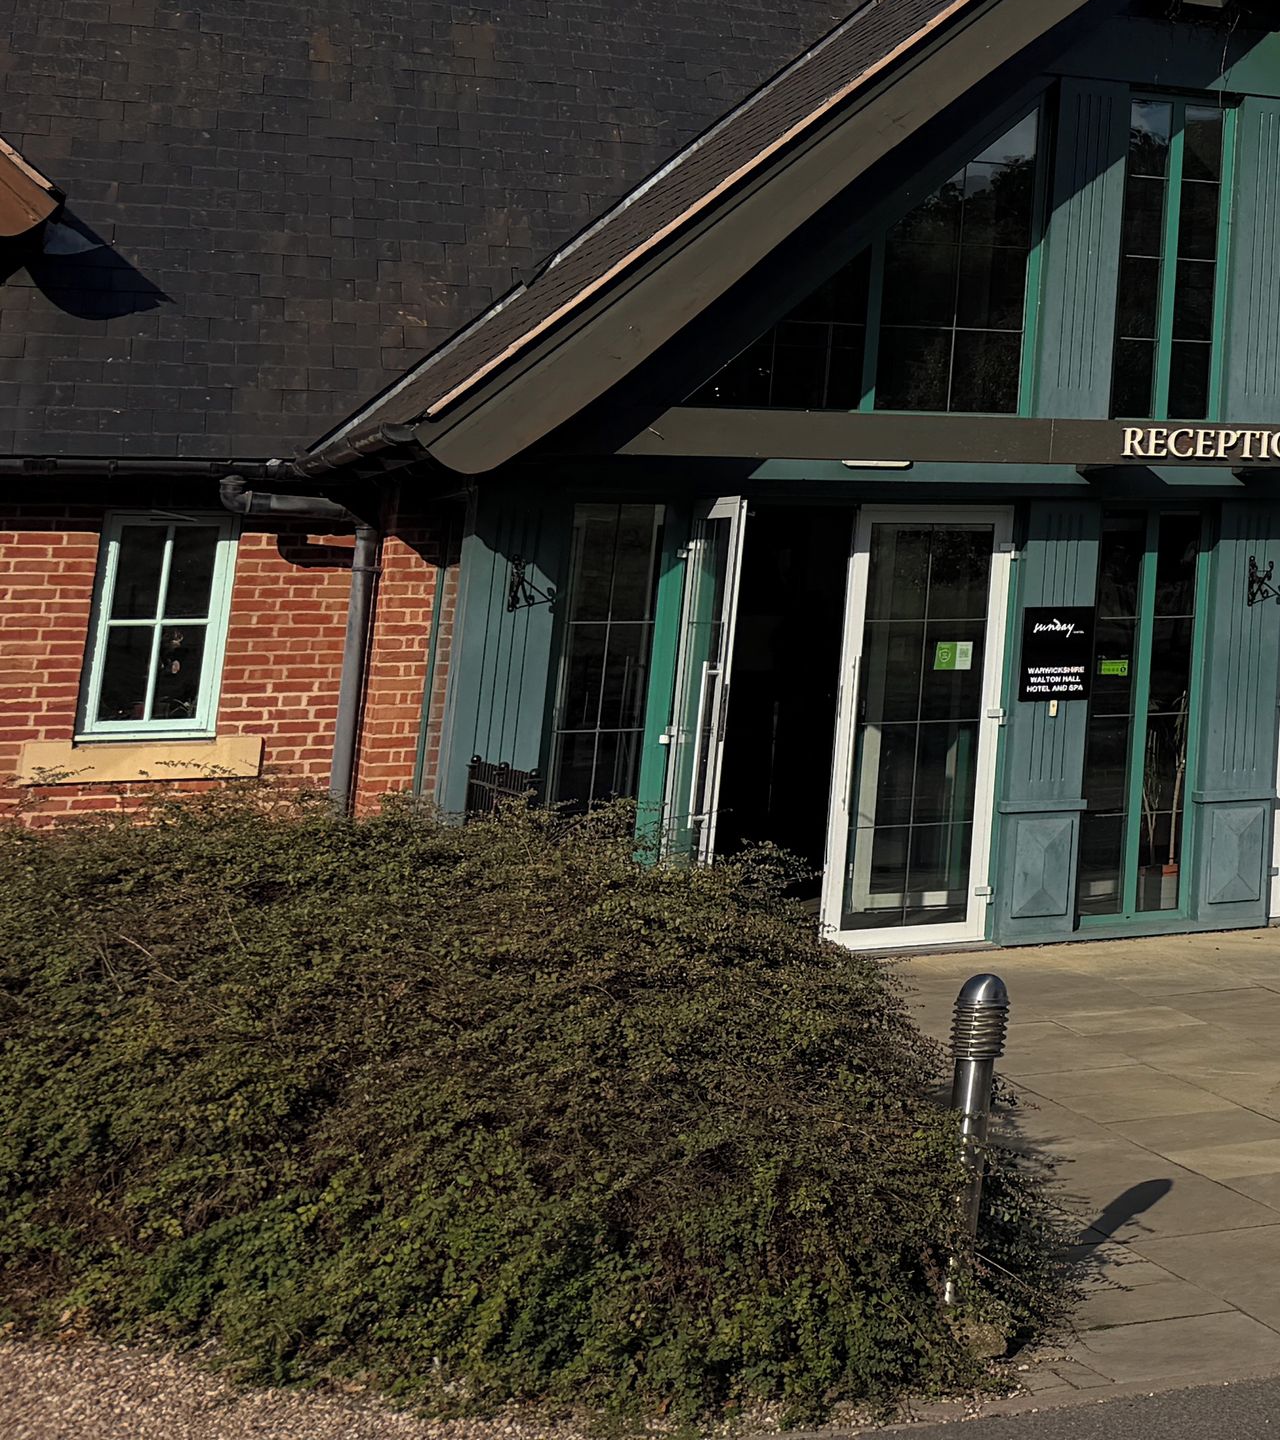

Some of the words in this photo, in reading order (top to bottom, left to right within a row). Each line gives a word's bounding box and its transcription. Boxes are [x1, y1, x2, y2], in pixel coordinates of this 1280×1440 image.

[1033, 618, 1075, 638] sunday
[1028, 665, 1085, 675] WARWICKSHIRE
[1029, 675, 1062, 684] WALTON
[1062, 675, 1081, 683] HALL
[1026, 684, 1051, 693] HOTEL
[1051, 684, 1067, 692] AND
